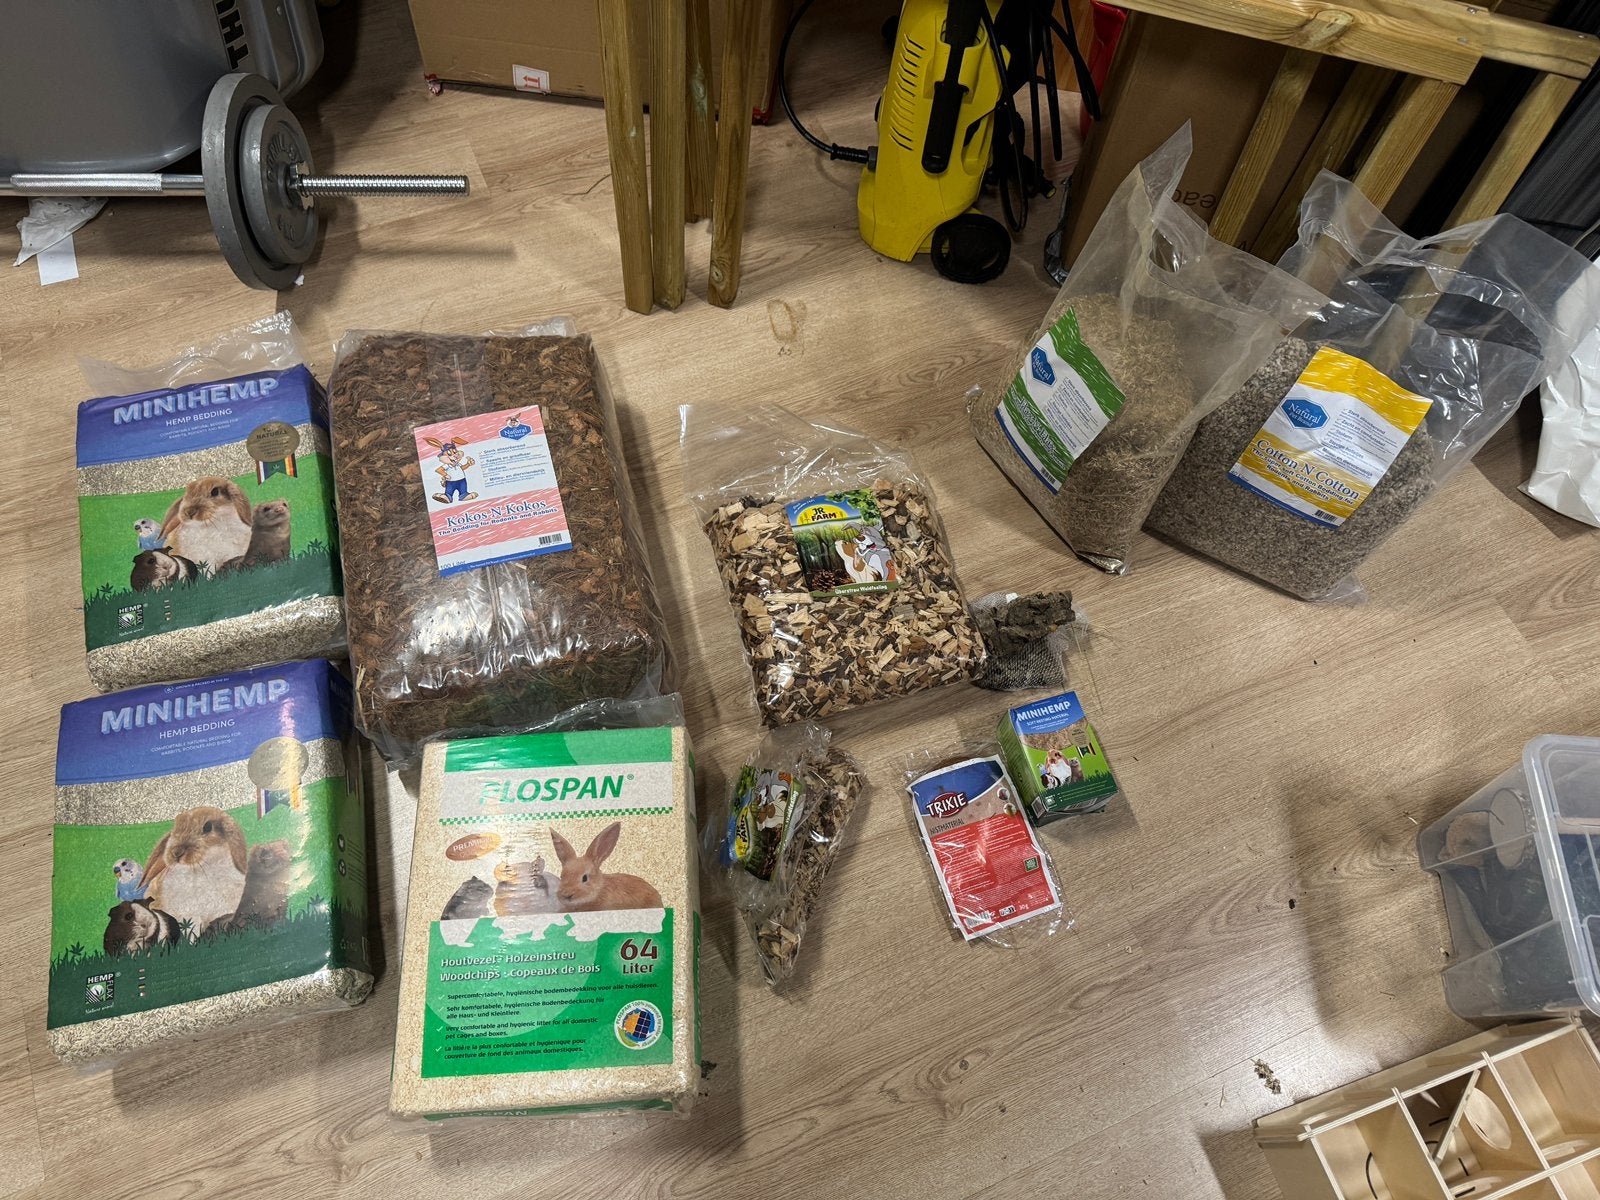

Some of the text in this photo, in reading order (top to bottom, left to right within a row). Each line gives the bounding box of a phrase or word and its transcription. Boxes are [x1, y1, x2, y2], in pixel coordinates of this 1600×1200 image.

[1032, 352, 1052, 381] Natural
[113, 377, 279, 426] MINIHEMP
[166, 408, 233, 427] HEMP BEDDING
[1288, 402, 1322, 425] Natural
[504, 426, 528, 437] Natural
[1252, 448, 1264, 457] The
[1295, 473, 1317, 487] Cotton
[1317, 484, 1344, 501] Bedding
[1257, 440, 1298, 469] Cotton
[1300, 463, 1316, 476] N
[1315, 470, 1360, 500] Cotton
[1267, 464, 1330, 500] Rodents and Rabbits
[446, 500, 547, 527] Kokos N Kokos
[811, 506, 826, 516] JR
[811, 512, 837, 522] FARM
[438, 529, 451, 537] The
[452, 522, 480, 534] Bedding
[491, 515, 518, 525] Rodents
[532, 507, 558, 518] Rabbits
[118, 604, 143, 614] HEMP
[101, 679, 291, 735] MINIHEMP
[1016, 701, 1071, 722] MINIHEMP
[159, 718, 236, 740] HEMP BEDDING
[926, 792, 967, 818] TRIXIE
[441, 951, 576, 967] Houtvezel Holzeinstreu
[620, 938, 658, 961] 64
[440, 963, 601, 982] Woodchips Copeaux de Bois
[622, 962, 655, 975] Liter
[87, 973, 114, 984] HEMP
[543, 985, 598, 995] bodembedekking
[542, 998, 595, 1007] Bodenbedeckung
[457, 1031, 475, 1039] cages
[488, 1029, 508, 1037] boxes.
[460, 1022, 496, 1032] comfortable
[496, 1021, 509, 1029] and
[510, 1020, 536, 1029] hygienic
[444, 1052, 478, 1060] couverture
[514, 1048, 542, 1056] animaux
[478, 1042, 492, 1051] plus
[493, 1040, 528, 1049] confortable
